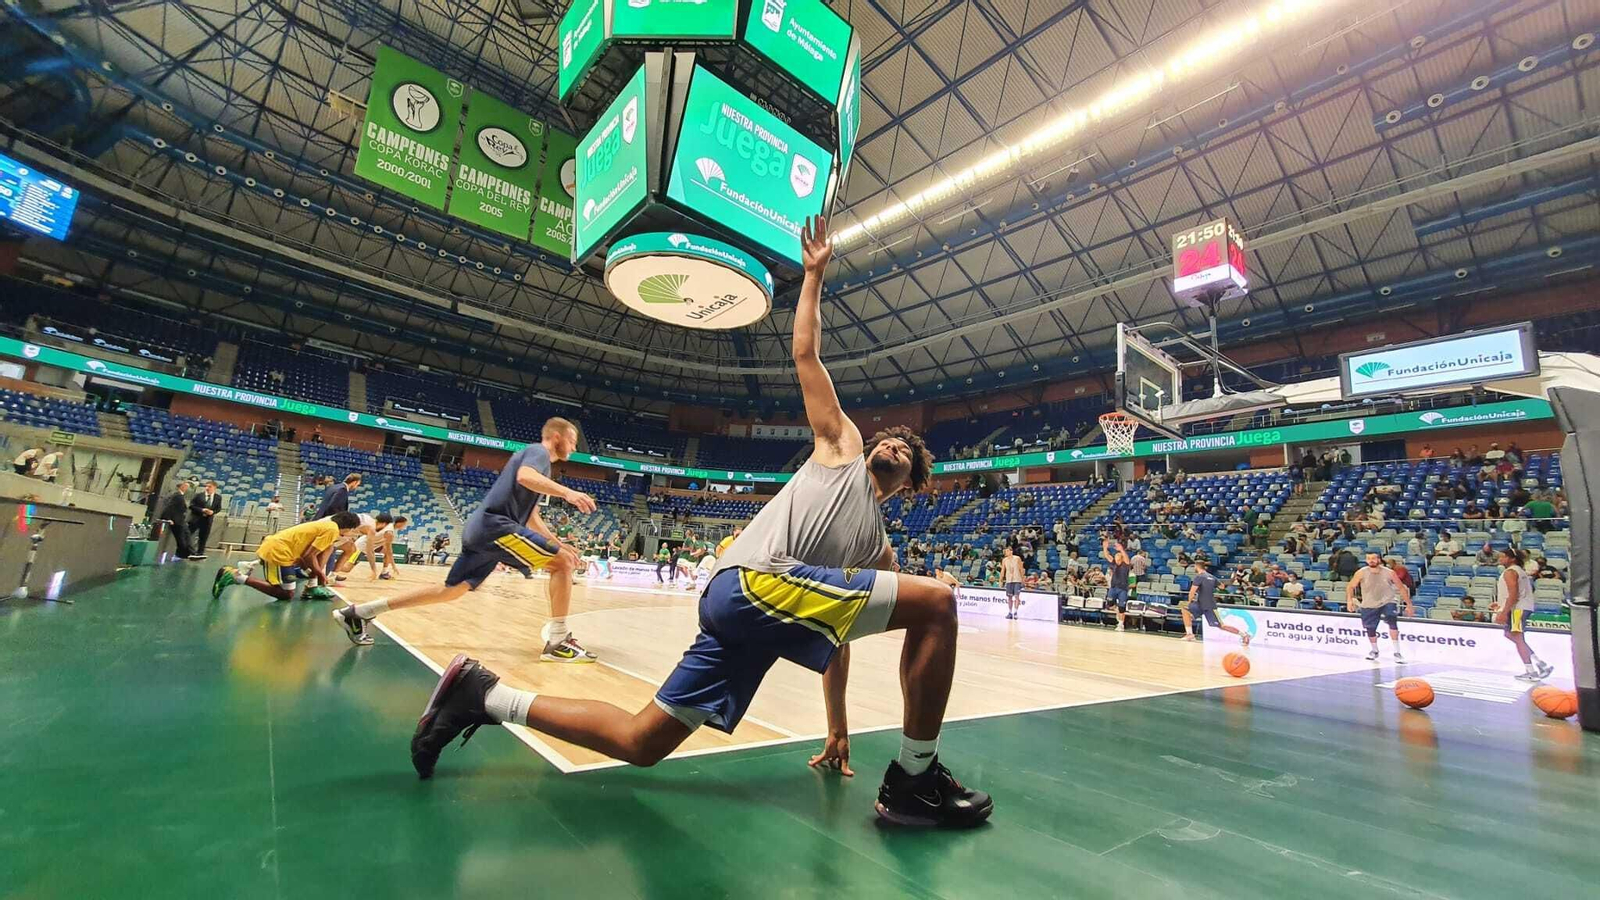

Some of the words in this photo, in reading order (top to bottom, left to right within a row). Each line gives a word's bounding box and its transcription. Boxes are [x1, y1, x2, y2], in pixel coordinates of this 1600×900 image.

[787, 29, 797, 41] de
[798, 36, 824, 61] Málaga
[790, 17, 837, 60] Ayuntamiento
[700, 101, 787, 179] Juega
[721, 102, 753, 132] NUESTRA
[754, 123, 788, 155] PROVINCIA
[367, 121, 450, 171] CAMPEONES
[369, 140, 401, 161] COPA
[404, 154, 444, 179] KORAC
[377, 158, 432, 190] 2000/2001
[459, 164, 531, 206] CAMPEONES
[455, 179, 485, 197] COPA
[487, 190, 507, 205] DEL
[510, 200, 530, 214] REY
[479, 202, 504, 218] 2005
[540, 196, 573, 221] CAMP
[555, 219, 573, 236] AC
[1176, 222, 1226, 249] 21:50
[1178, 240, 1221, 278] 24
[685, 292, 738, 320] Unicaja
[193, 383, 233, 399] NUESTRA
[235, 391, 278, 407] PROVINCIA
[280, 398, 317, 415] Juega
[448, 432, 475, 444] NUESTRA
[475, 436, 505, 448] PROVINCIA
[1152, 440, 1188, 453] NUESTRA
[1190, 435, 1236, 449] PROVINCIA
[1236, 430, 1281, 445] Juega
[943, 461, 965, 472] NUESTRA
[966, 458, 993, 470] PROVINCIA
[993, 456, 1021, 468] Juega
[969, 595, 991, 603] manos
[1266, 619, 1313, 633] Lavado
[1317, 624, 1334, 635] de
[1400, 633, 1477, 648] recuente
[1266, 630, 1286, 639] con
[1288, 633, 1314, 644] agua
[1316, 635, 1323, 644] y
[1324, 634, 1359, 646] jabón
